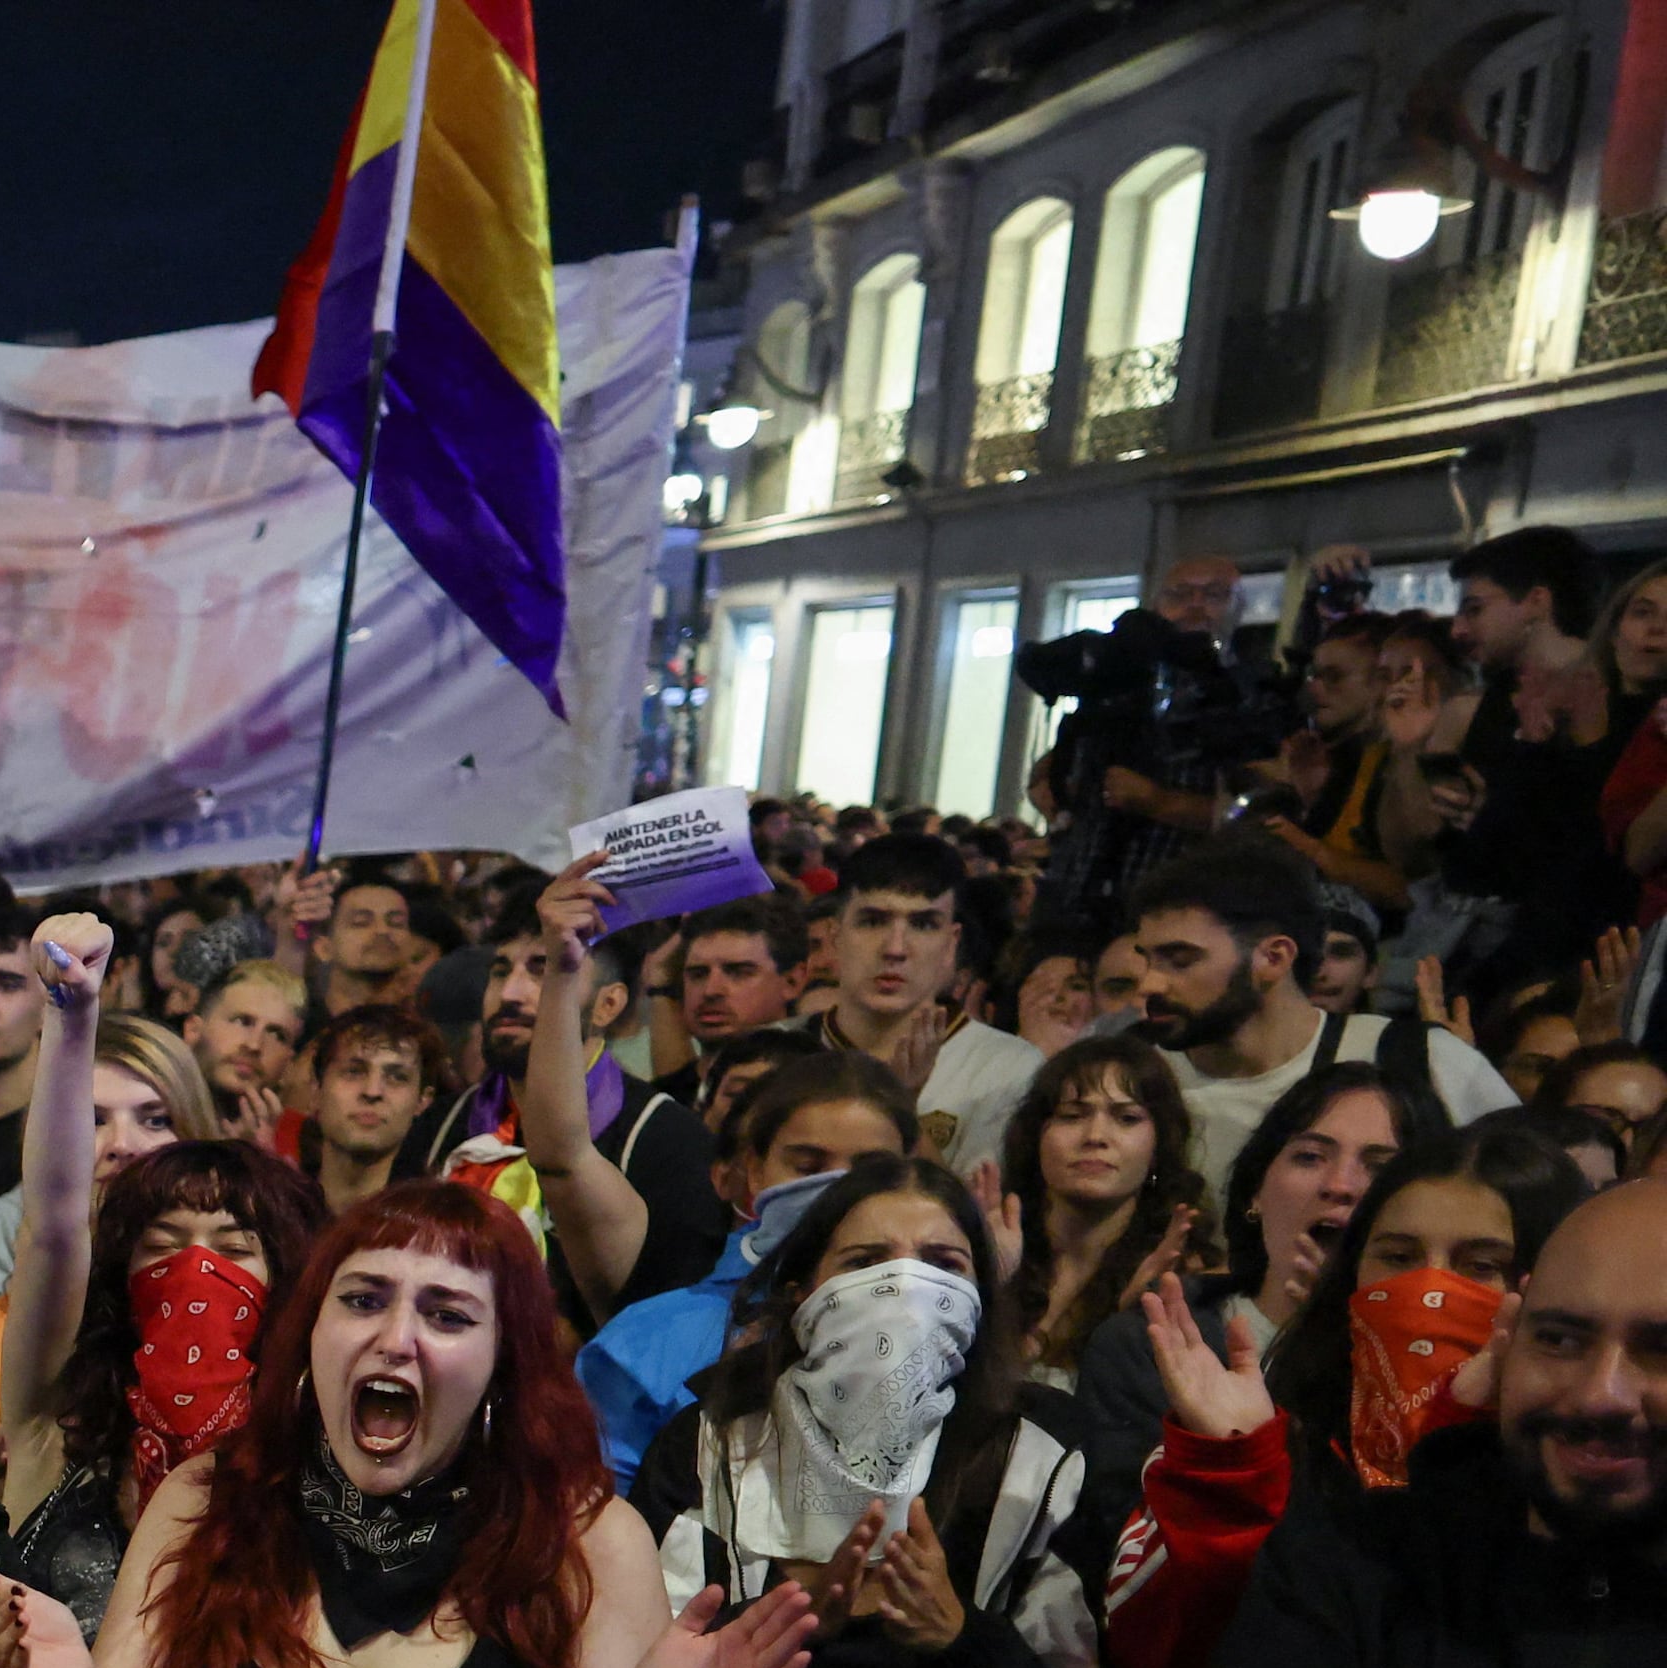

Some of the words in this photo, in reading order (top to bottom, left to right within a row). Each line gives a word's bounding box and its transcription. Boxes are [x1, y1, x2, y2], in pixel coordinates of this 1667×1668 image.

[685, 809, 706, 823] LA
[608, 834, 667, 855] AMPADA
[669, 828, 691, 842] EN
[693, 821, 724, 836] SOL
